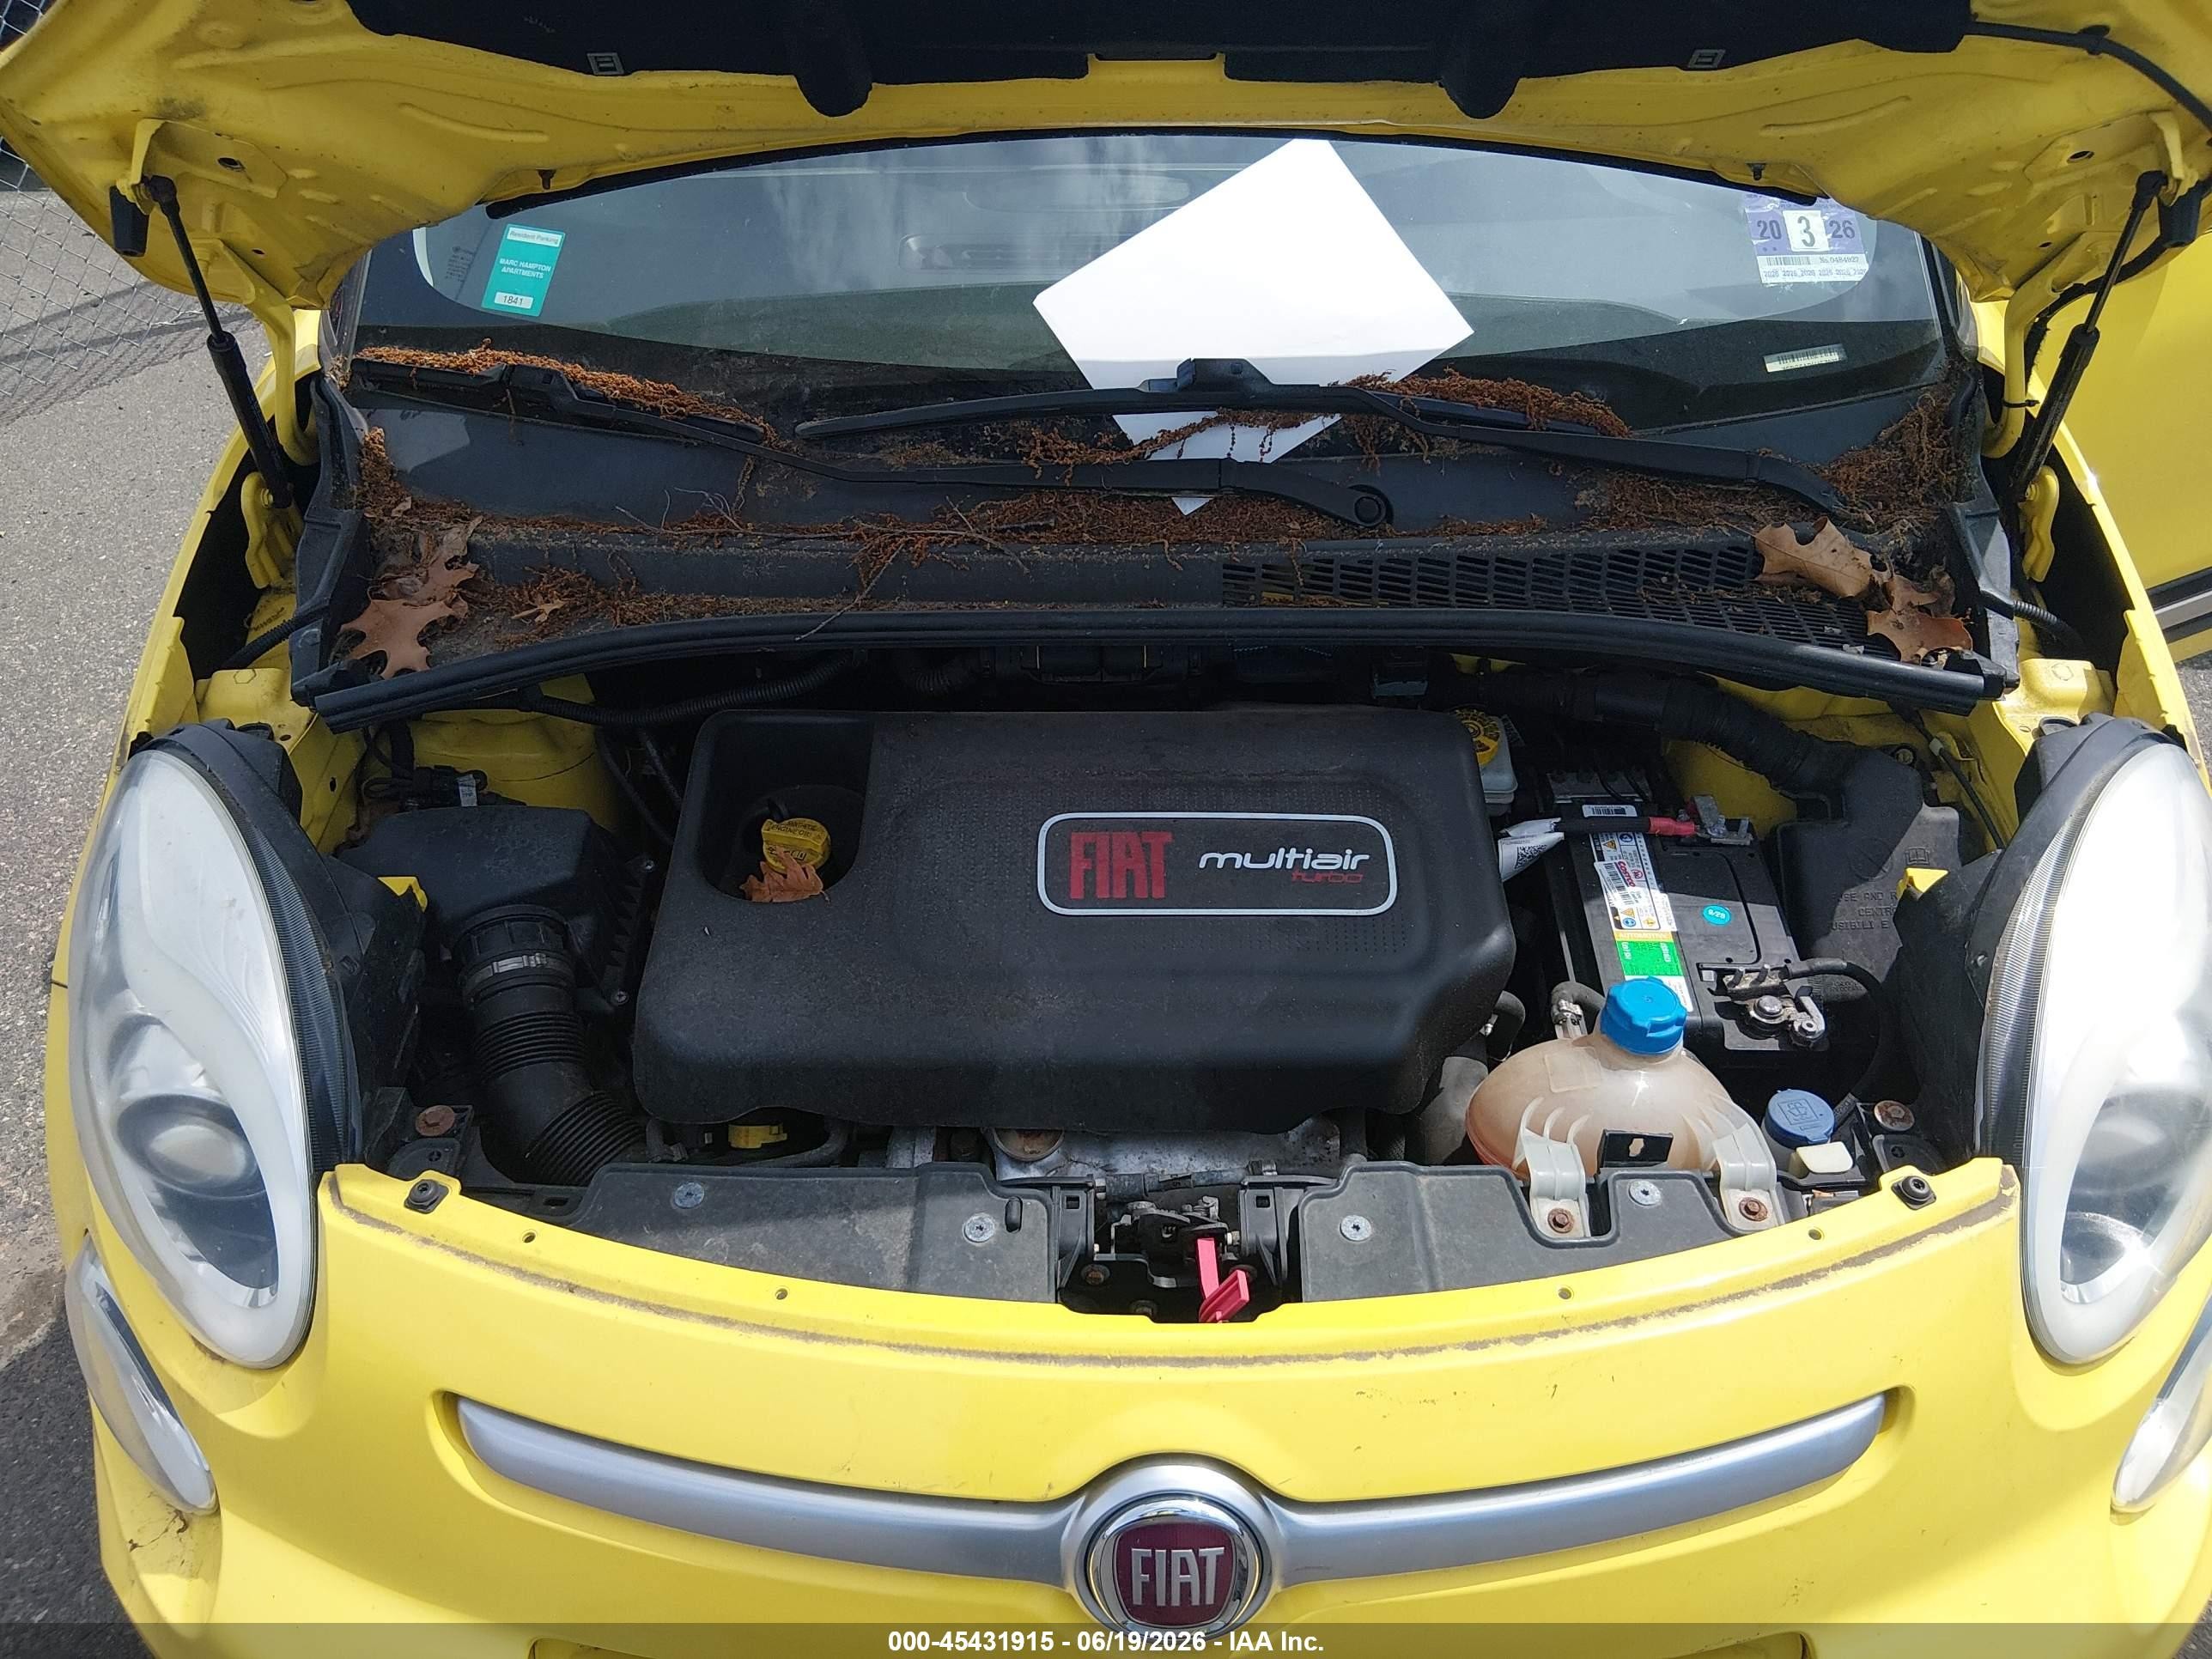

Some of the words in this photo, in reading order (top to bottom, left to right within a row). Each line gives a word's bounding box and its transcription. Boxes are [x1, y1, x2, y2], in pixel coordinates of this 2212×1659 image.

[1757, 220, 1782, 240] 20
[1797, 216, 1815, 247] 3
[1829, 220, 1856, 239] 26
[500, 258, 518, 267] MARC
[520, 261, 551, 272] HAMPTON
[501, 266, 544, 278] APARTMENTS
[503, 295, 524, 306] 1841
[1069, 831, 1173, 899] FIAT
[1199, 848, 1370, 870] multiair
[1291, 870, 1364, 884] turbo
[1618, 860, 1636, 888] COSTCO
[1863, 892, 1883, 901] AND
[1131, 1547, 1224, 1607] FIAT
